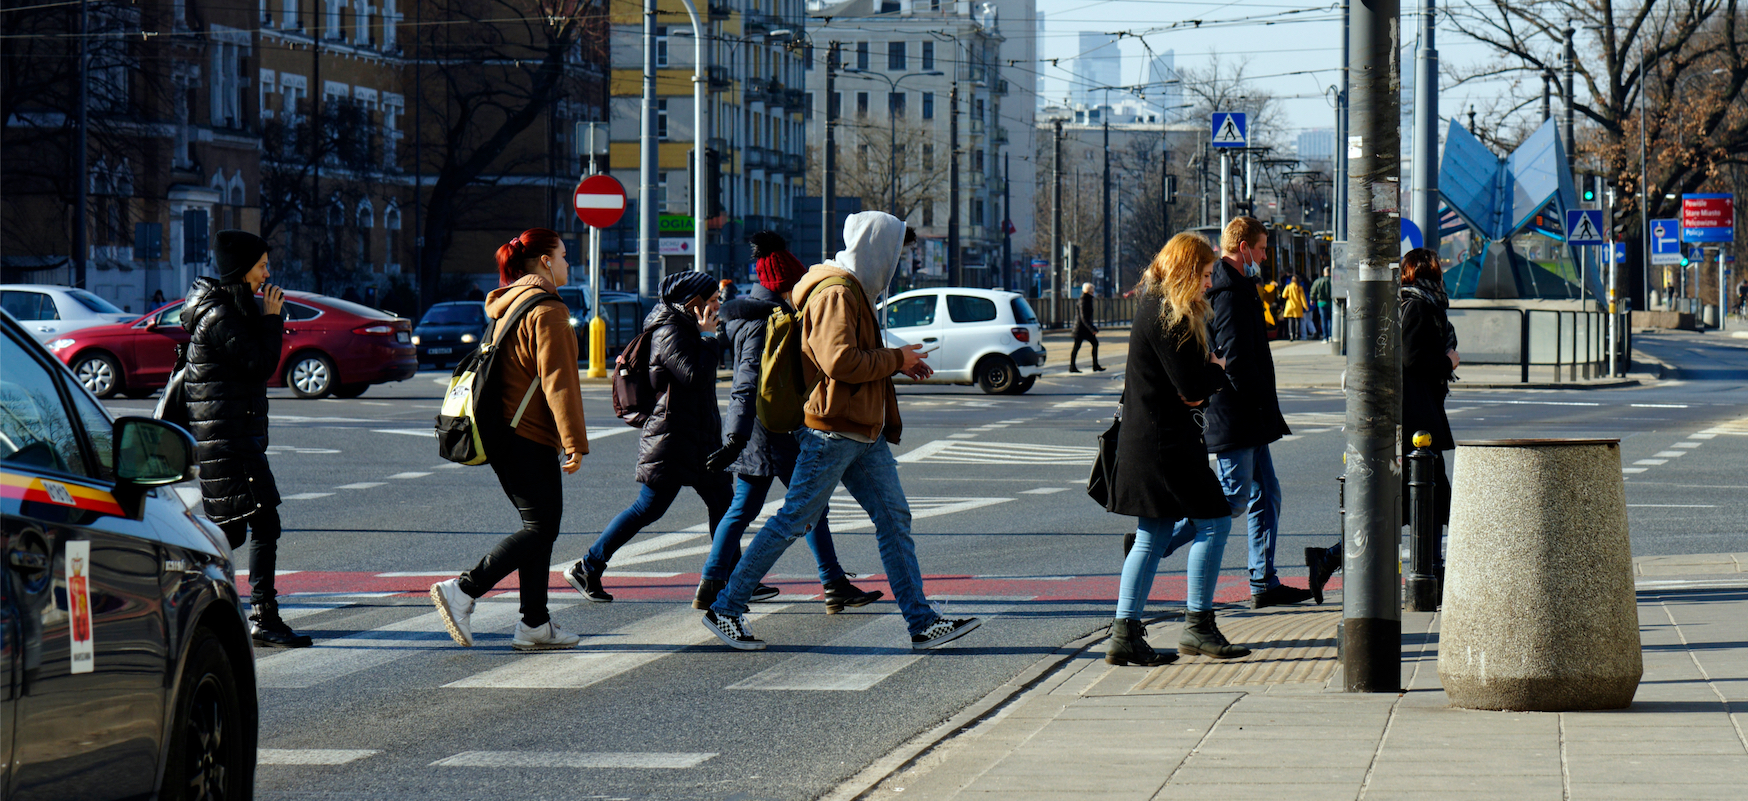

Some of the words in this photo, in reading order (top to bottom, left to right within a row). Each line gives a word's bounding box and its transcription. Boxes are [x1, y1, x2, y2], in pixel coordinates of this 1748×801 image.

[1685, 209, 1700, 217] Stare
[1701, 209, 1721, 217] Miasto
[660, 219, 694, 228] OGIA
[1686, 228, 1704, 237] Policja
